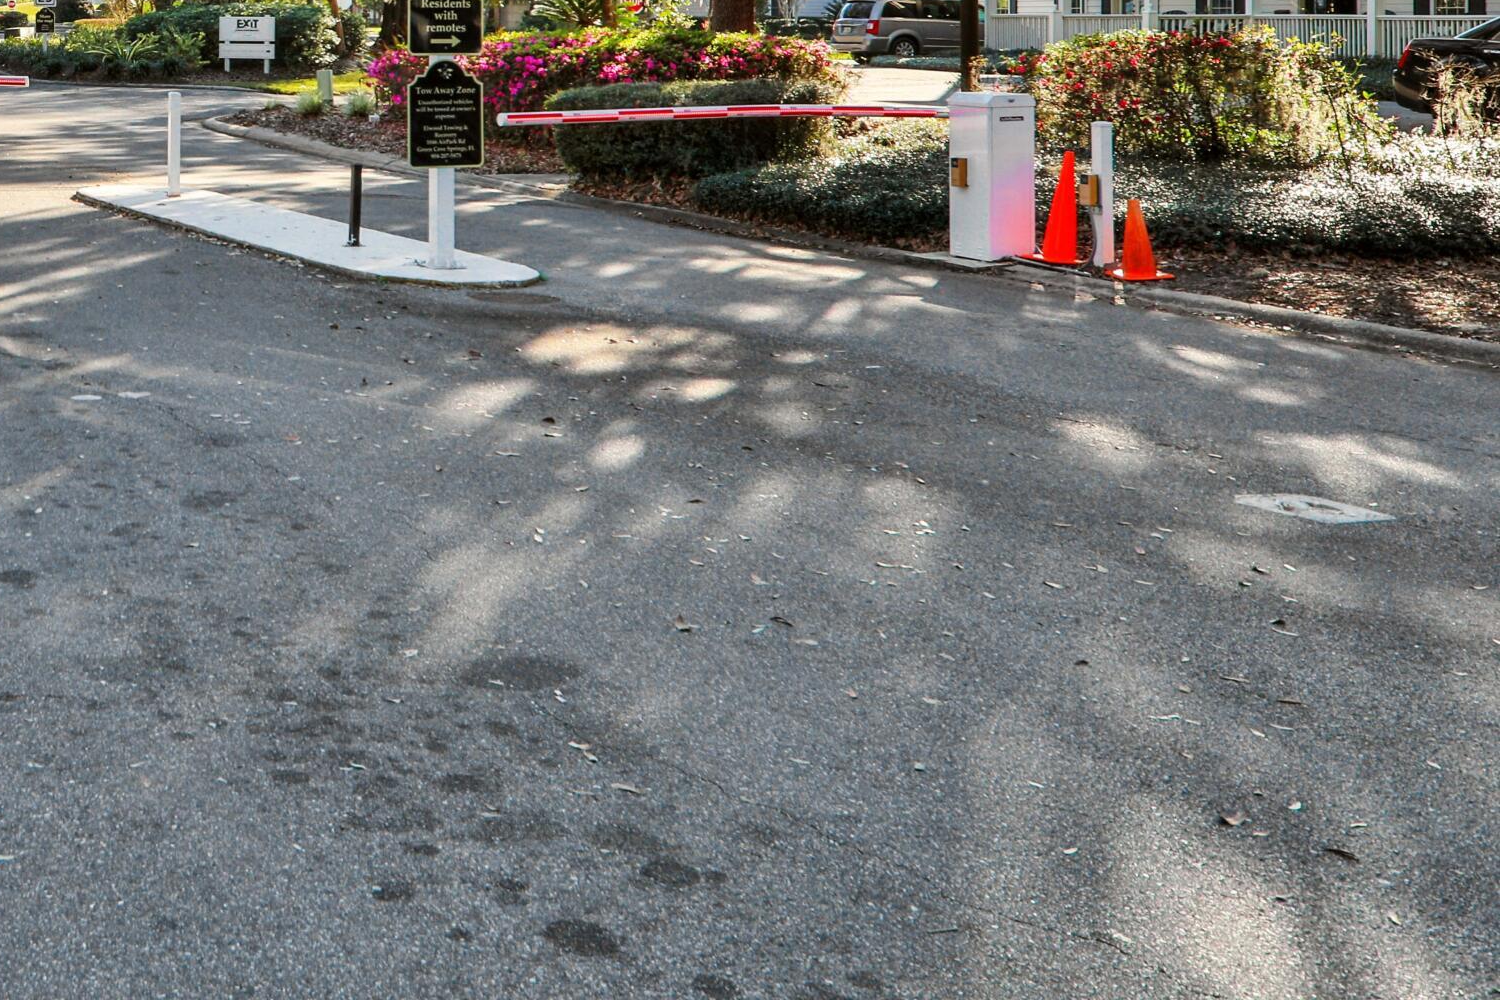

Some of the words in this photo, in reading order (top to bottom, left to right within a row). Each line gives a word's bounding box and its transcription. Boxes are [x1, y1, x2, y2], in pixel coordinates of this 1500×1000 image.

[434, 10, 458, 20] with
[426, 23, 467, 33] remotes
[416, 87, 432, 95] Tow
[434, 87, 454, 96] Away
[456, 86, 476, 94] Zone
